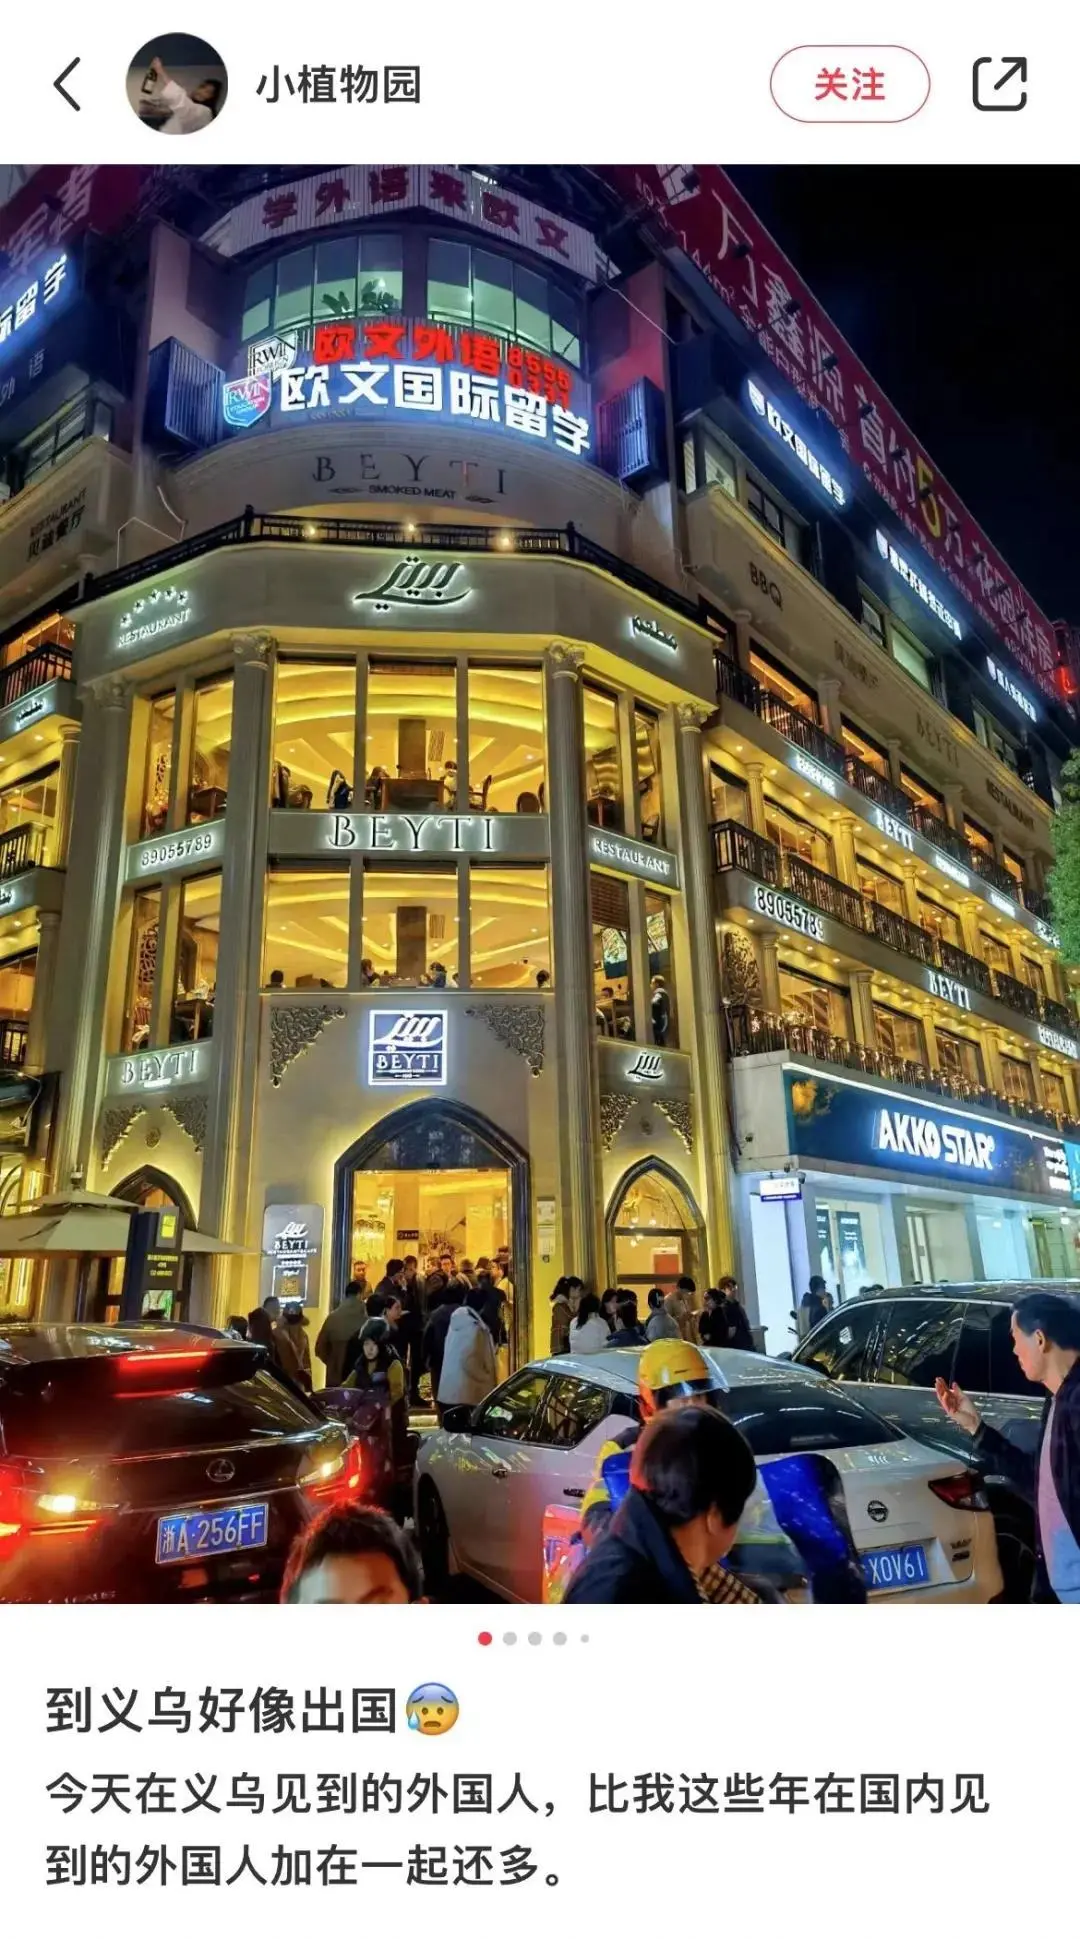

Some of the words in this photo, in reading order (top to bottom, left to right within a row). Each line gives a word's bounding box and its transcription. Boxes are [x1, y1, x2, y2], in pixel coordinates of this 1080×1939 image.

[262, 166, 570, 259] 学外语来欧文
[314, 322, 502, 378] 欧文外语
[508, 346, 572, 391] 8555
[280, 360, 592, 455] 欧文国际留学
[312, 452, 508, 496] BEYTI
[368, 483, 421, 498] SMOKED
[423, 486, 457, 501] MEAT
[747, 562, 783, 611] BBQ
[118, 607, 192, 648] RESTAURANT
[140, 833, 213, 867] 89055789
[328, 813, 497, 851] BEYTI
[593, 837, 671, 876] RESTAURANT
[754, 886, 825, 939] 89055789
[927, 970, 972, 1013] BEYTI
[120, 1047, 200, 1086] BEYTI
[376, 1053, 439, 1070] BEYTI
[879, 1108, 941, 1160] AKKO
